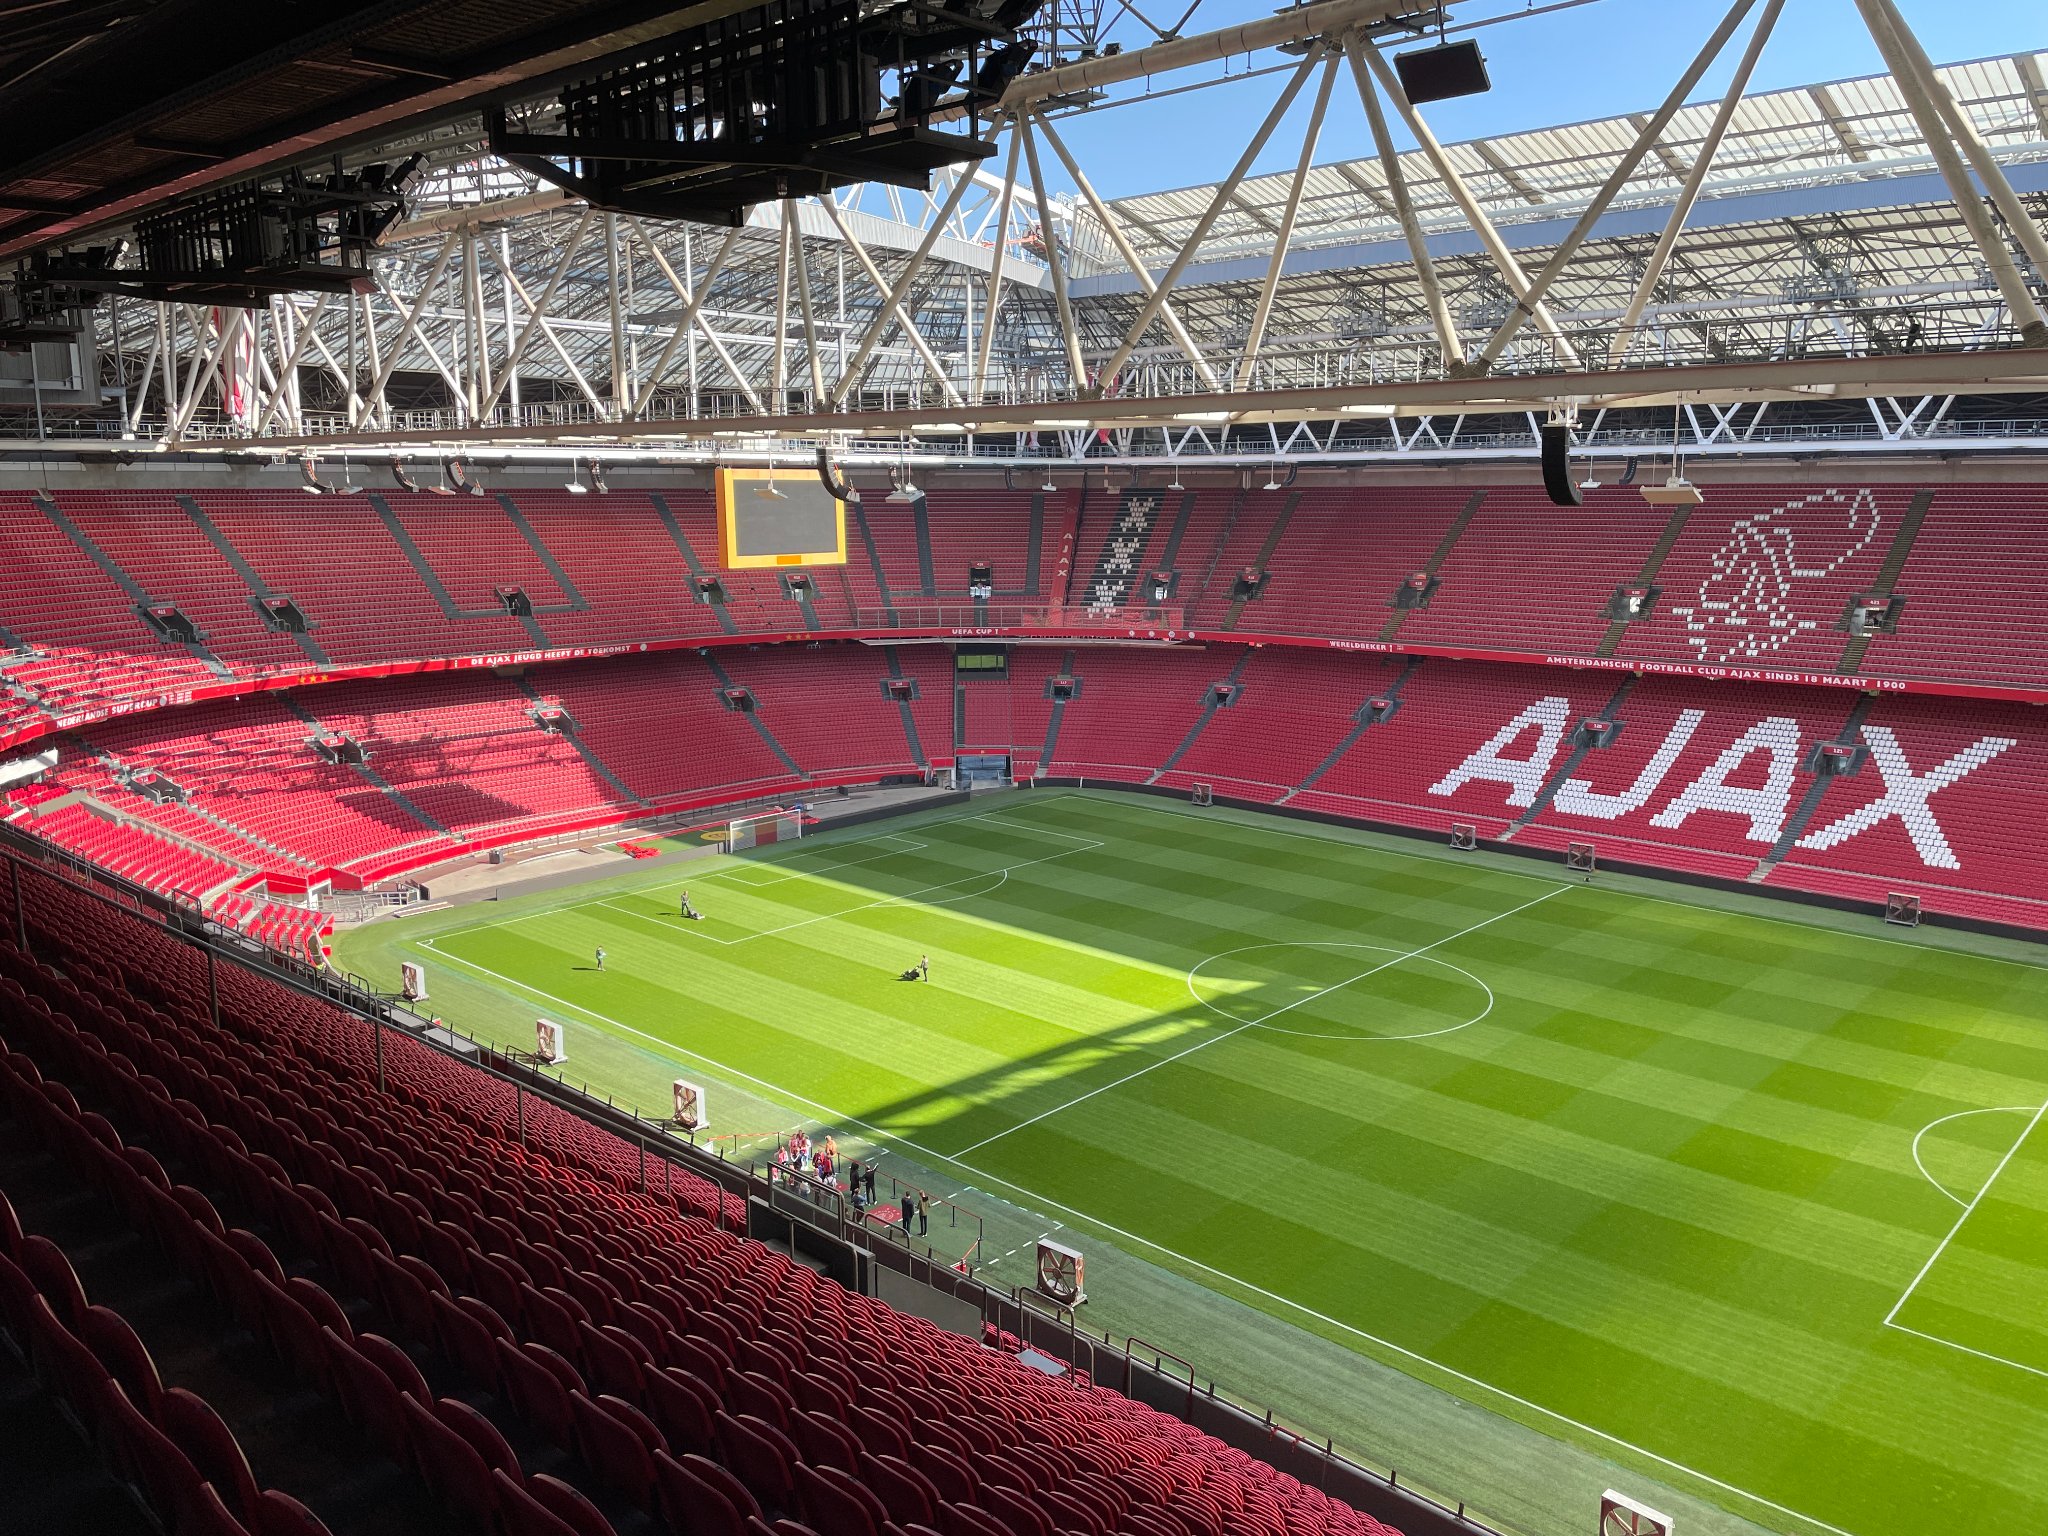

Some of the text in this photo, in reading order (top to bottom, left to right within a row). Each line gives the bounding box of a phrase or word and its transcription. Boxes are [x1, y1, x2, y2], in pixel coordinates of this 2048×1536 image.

[1057, 532, 1074, 577] AJAX
[486, 655, 511, 665] AJAX
[513, 652, 542, 663] JEUGD
[544, 650, 571, 658] HEEFT
[588, 645, 631, 655] TOEKOMST
[1329, 640, 1386, 651] WERELDBEKER
[1546, 656, 1906, 689] AMSTERDAMSCHE FOOTBALL CLUB AJAX SINDS 18 MAART 1900
[56, 698, 158, 728] NEDERLANDSE SUPERCUP
[1428, 696, 2017, 870] AJAX
